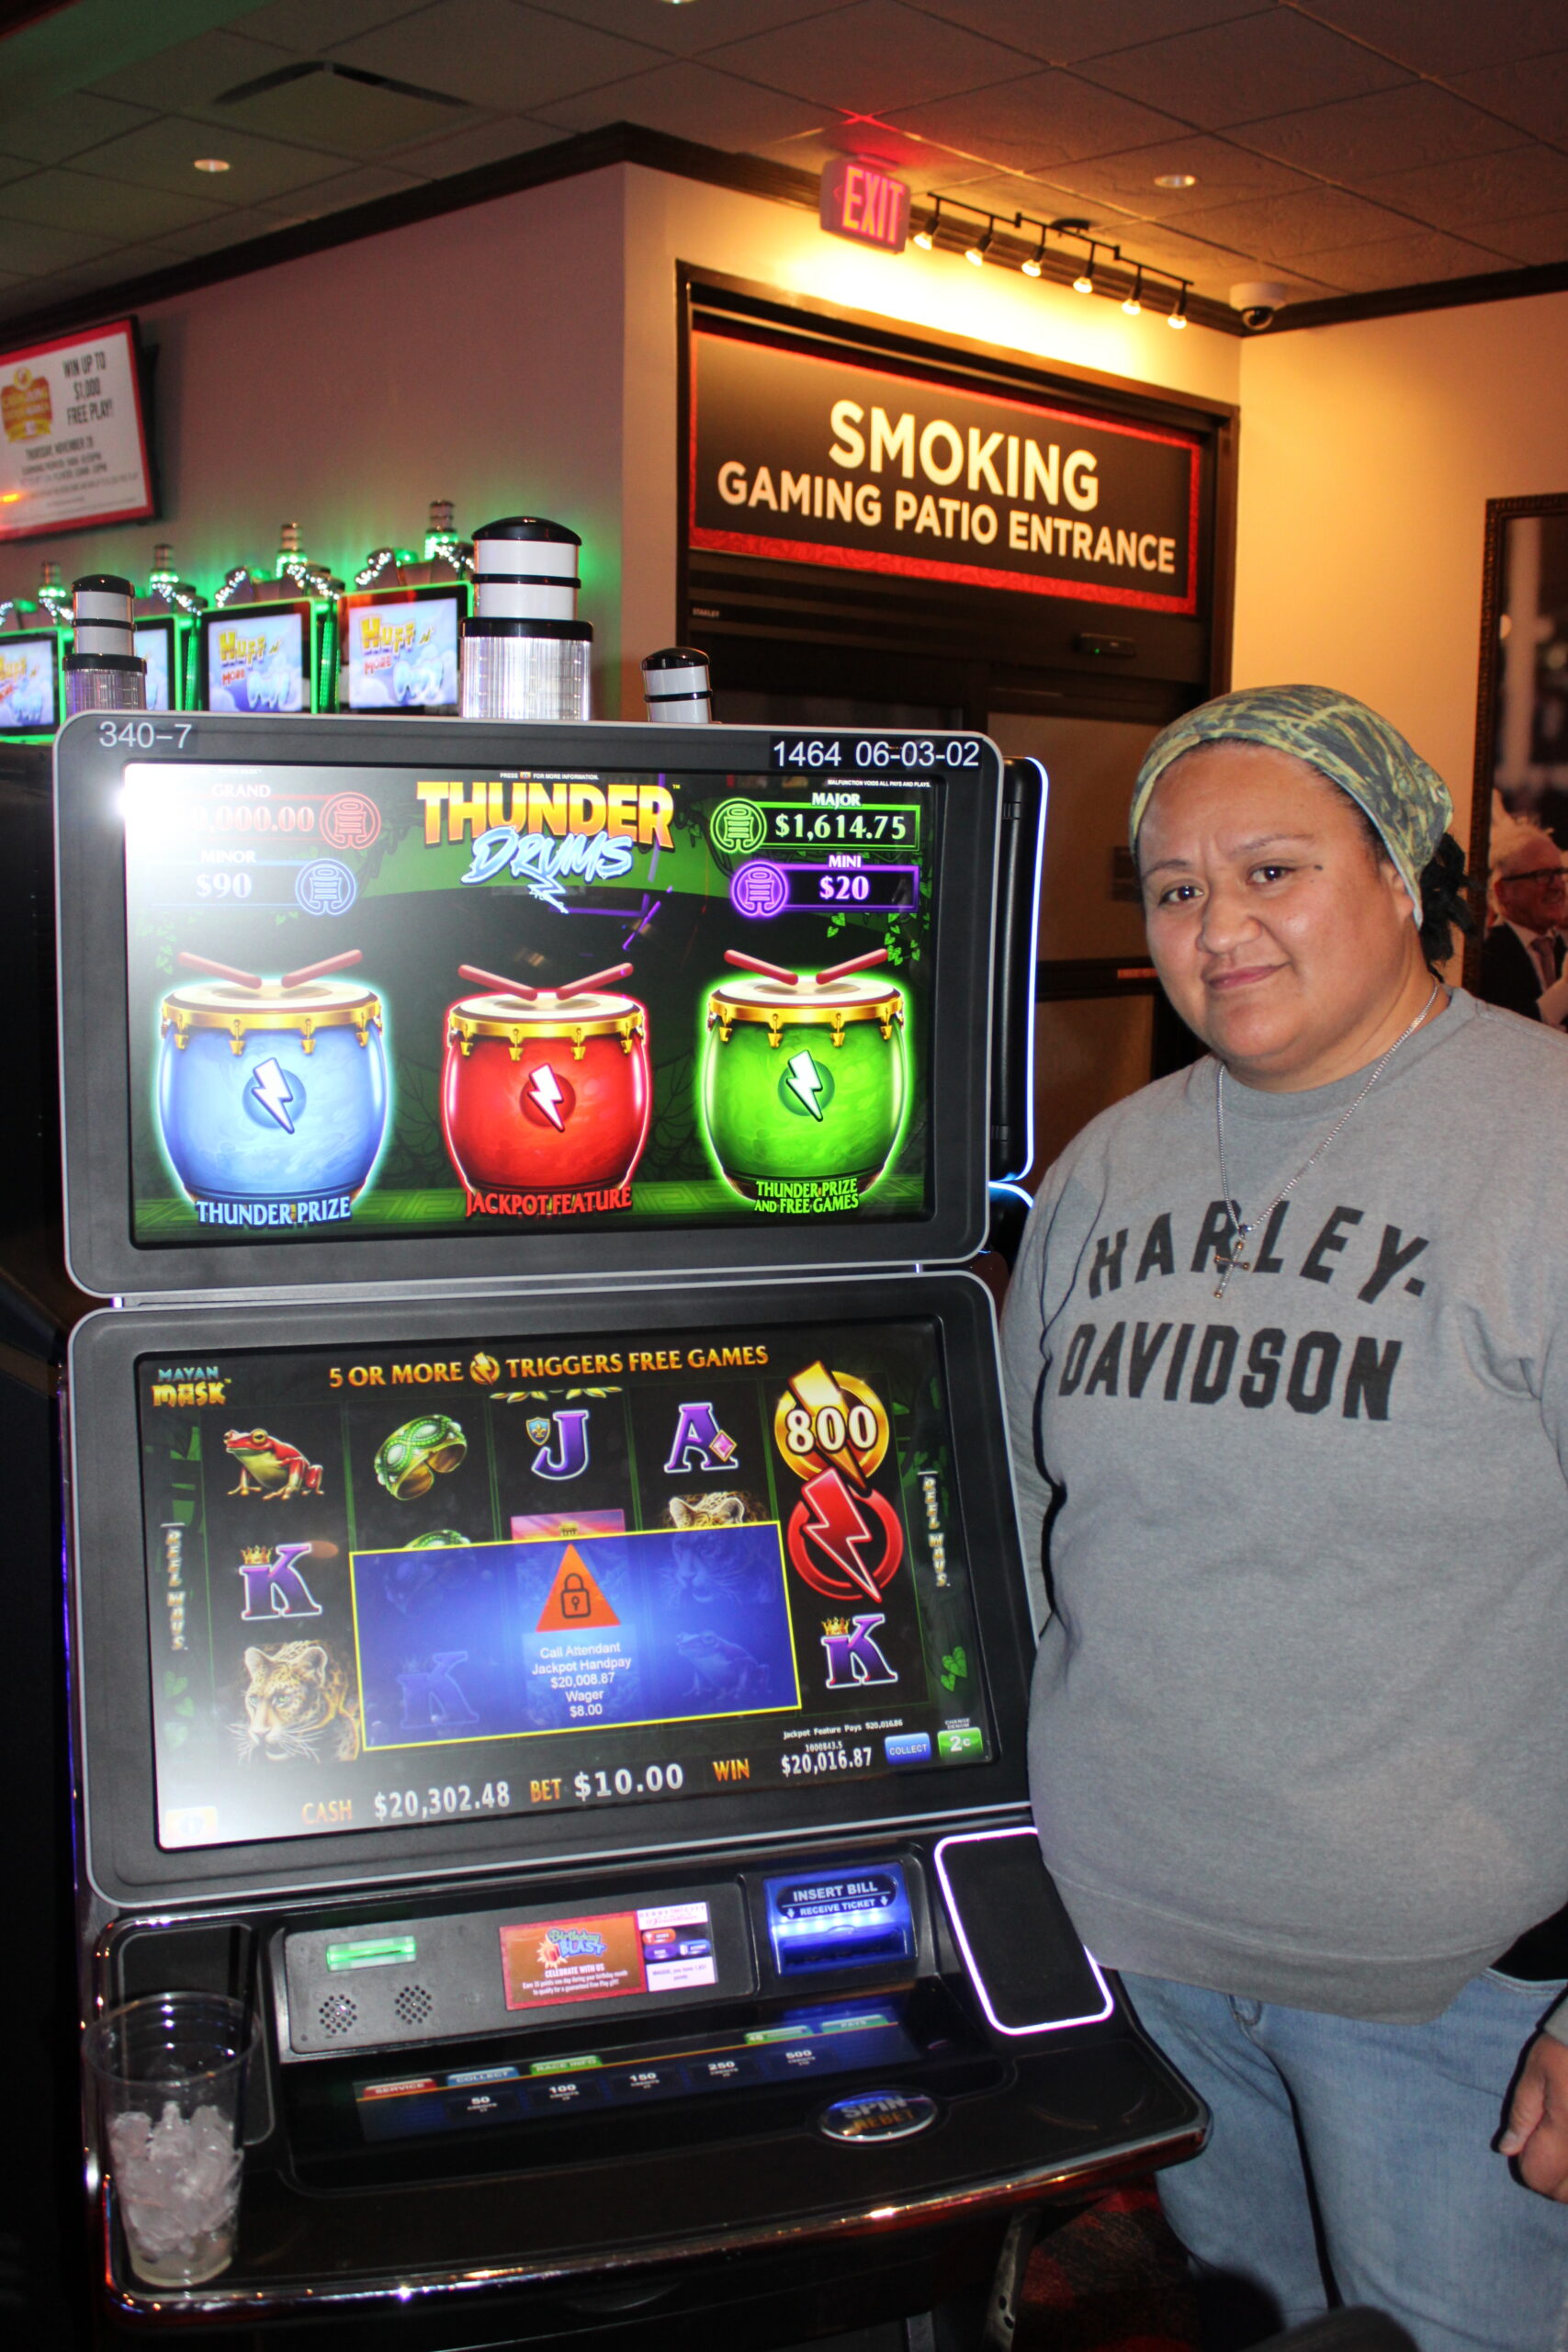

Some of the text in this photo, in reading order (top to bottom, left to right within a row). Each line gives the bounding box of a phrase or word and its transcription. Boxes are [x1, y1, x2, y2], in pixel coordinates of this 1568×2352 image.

[841, 164, 906, 246] EXIT
[62, 350, 107, 379] WIN UP TO
[66, 403, 88, 426] FREE
[829, 400, 1099, 512] SMOKING
[717, 461, 1176, 574] GAMING PATIO ENTRANCE
[99, 721, 193, 749] 340-7
[773, 741, 980, 767] 1464 06-03-02
[211, 784, 271, 798] GRAND
[811, 792, 861, 809] MAJOR
[416, 781, 675, 849] THUNDER
[775, 813, 907, 842] $1,614.75
[200, 850, 257, 864] MINOR
[460, 826, 634, 884] DRUMS
[829, 854, 862, 868] MINI
[196, 872, 253, 899] $90
[819, 876, 870, 900] $20
[755, 1178, 858, 1199] THUNDER PRIZE
[196, 1195, 351, 1226] THUNDER PRIZE
[465, 1186, 632, 1216] JACKPOT FEATURE
[754, 1193, 859, 1214] AND FREE GAMES
[505, 1345, 769, 1378] TRIGGERS FREE GAMES
[1058, 1320, 1403, 1421] DAVIDSON
[158, 1366, 219, 1381] MAYAN
[329, 1361, 464, 1388] 5 OR MORE
[152, 1381, 227, 1408] MASK
[664, 1402, 739, 1473] A
[785, 1404, 879, 1454] 800
[531, 1409, 589, 1480] J
[239, 1542, 322, 1621] K
[540, 1642, 621, 1659] Call Attendant
[820, 1613, 898, 1689] K
[532, 1657, 632, 1676] Jackpot Handpay
[550, 1672, 615, 1690] $20,008.87
[565, 1690, 604, 1703] Wager
[569, 1703, 603, 1718] $8.00
[783, 1728, 811, 1740] Jackpot
[814, 1725, 841, 1736] Feature
[844, 1724, 862, 1734] Pays
[889, 1744, 928, 1756] COLLECT
[713, 1747, 872, 1782] WIN $20,016.87
[530, 1762, 684, 1804] BET $10.00
[301, 1781, 511, 1826] CASH $20,302.48
[794, 1882, 878, 1903] INSERT BILL
[800, 1898, 875, 1917] RECEIVE TICKET
[558, 1939, 607, 1958] BLAST
[545, 1962, 605, 1978] CELEBRATE WITH US
[536, 2058, 597, 2072] RACE INFO
[708, 2061, 735, 2071] 250
[785, 2050, 812, 2059] 500
[375, 2082, 425, 2095] SERVICE
[456, 2071, 509, 2083] COLLECT
[629, 2072, 657, 2082] 150
[471, 2096, 491, 2104] 50
[548, 2084, 576, 2094] 100
[840, 2096, 908, 2119] SPIN
